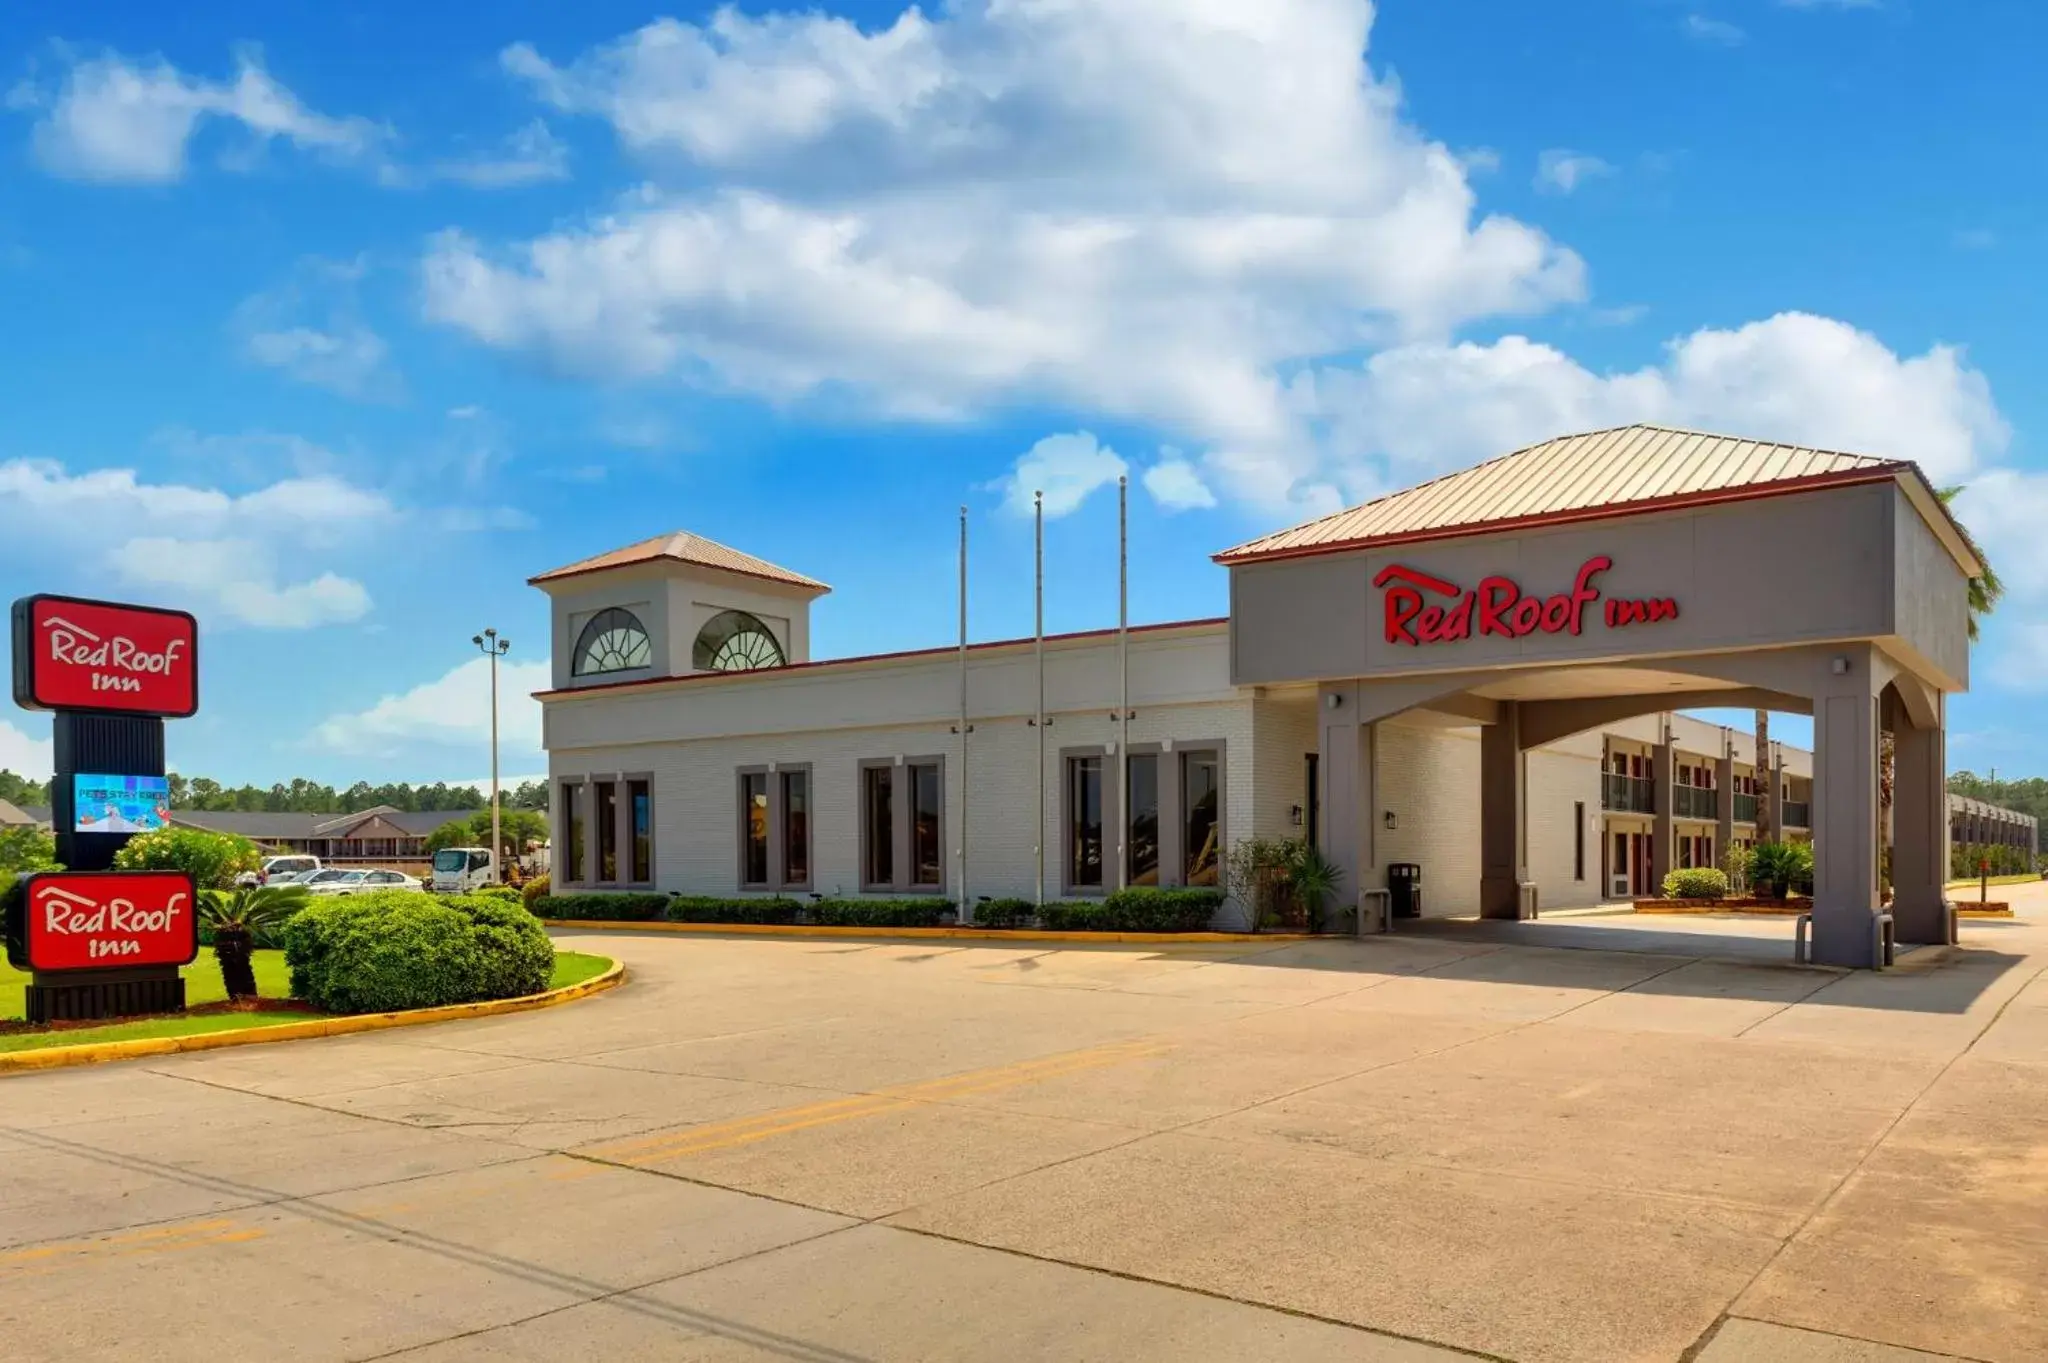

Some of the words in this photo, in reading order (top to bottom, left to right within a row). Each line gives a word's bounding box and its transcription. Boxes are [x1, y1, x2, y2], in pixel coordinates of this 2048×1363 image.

[1384, 586, 1477, 646] Red
[1477, 555, 1613, 639] Roof
[51, 629, 109, 666] Red
[111, 636, 185, 676] Roof
[79, 789, 107, 799] PETS
[45, 899, 105, 935] Red
[110, 892, 187, 933] Roof
